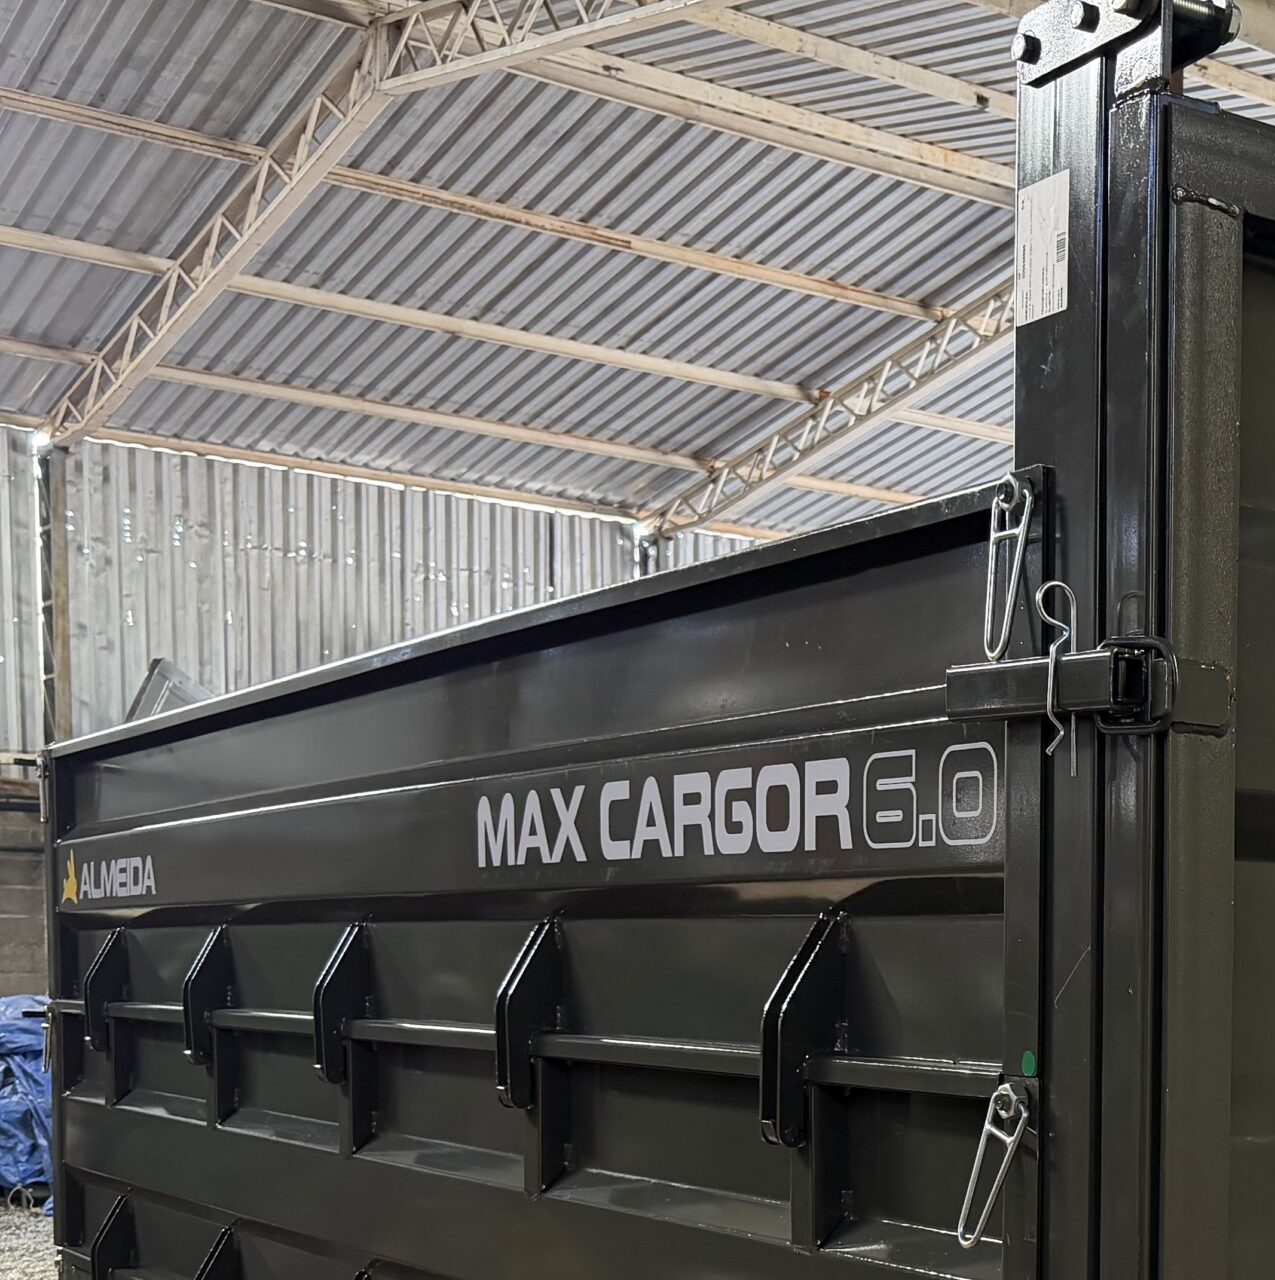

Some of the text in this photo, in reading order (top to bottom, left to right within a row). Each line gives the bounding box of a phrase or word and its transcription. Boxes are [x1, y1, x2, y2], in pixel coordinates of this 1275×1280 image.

[477, 741, 998, 868] MAX CARGOR 6.0
[79, 855, 156, 900] ALMEIDA
